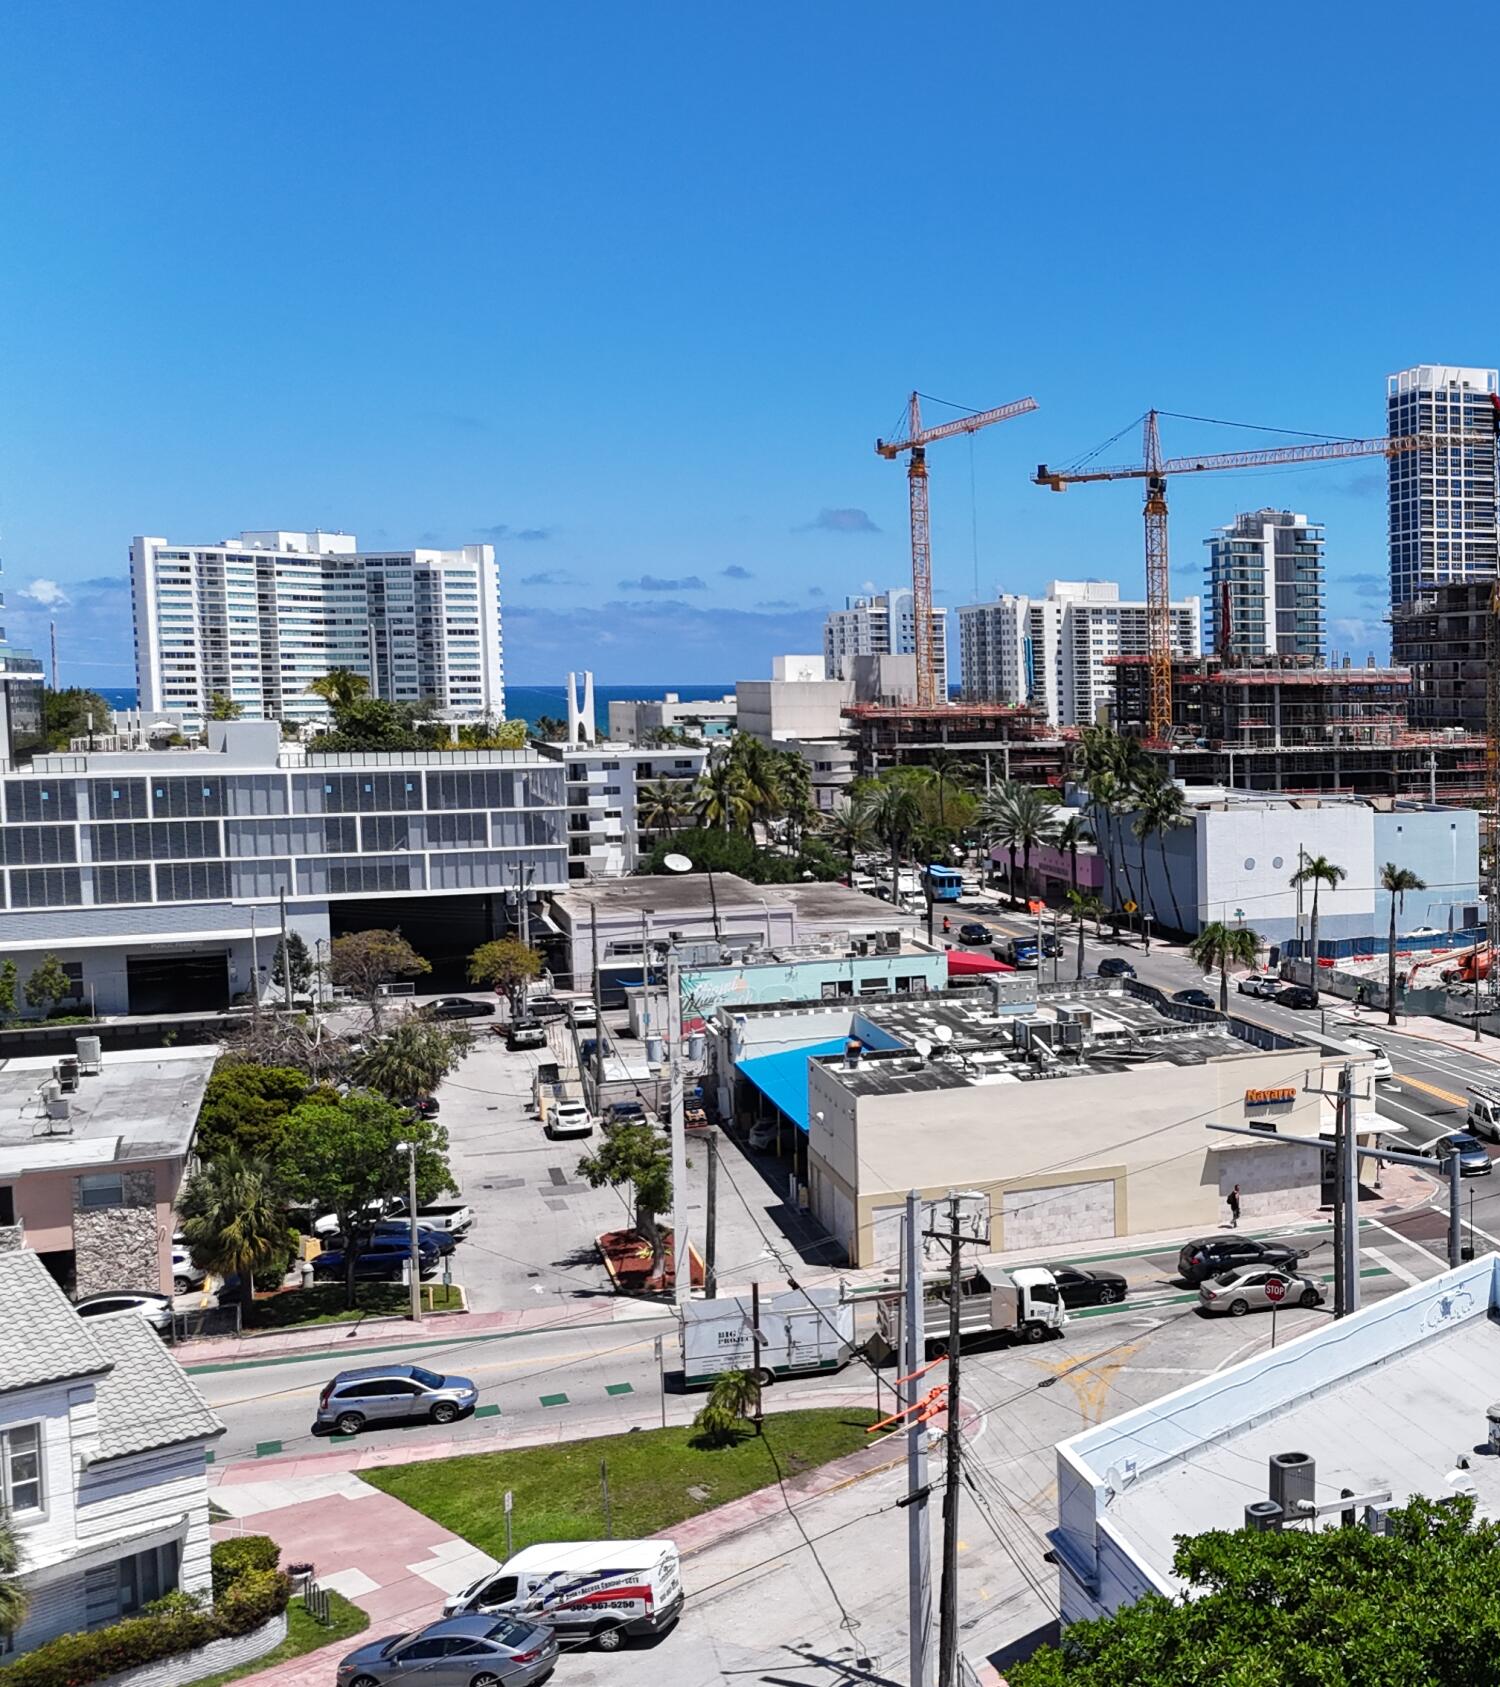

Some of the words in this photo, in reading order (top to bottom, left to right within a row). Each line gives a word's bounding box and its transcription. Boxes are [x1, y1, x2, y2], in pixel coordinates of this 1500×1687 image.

[1246, 1088, 1296, 1101] Navarro
[1266, 1286, 1285, 1295] STOP
[718, 1330, 736, 1338] BIG
[718, 1336, 753, 1345] PROJEC
[581, 1584, 600, 1595] Access
[625, 1576, 639, 1584] CCTV
